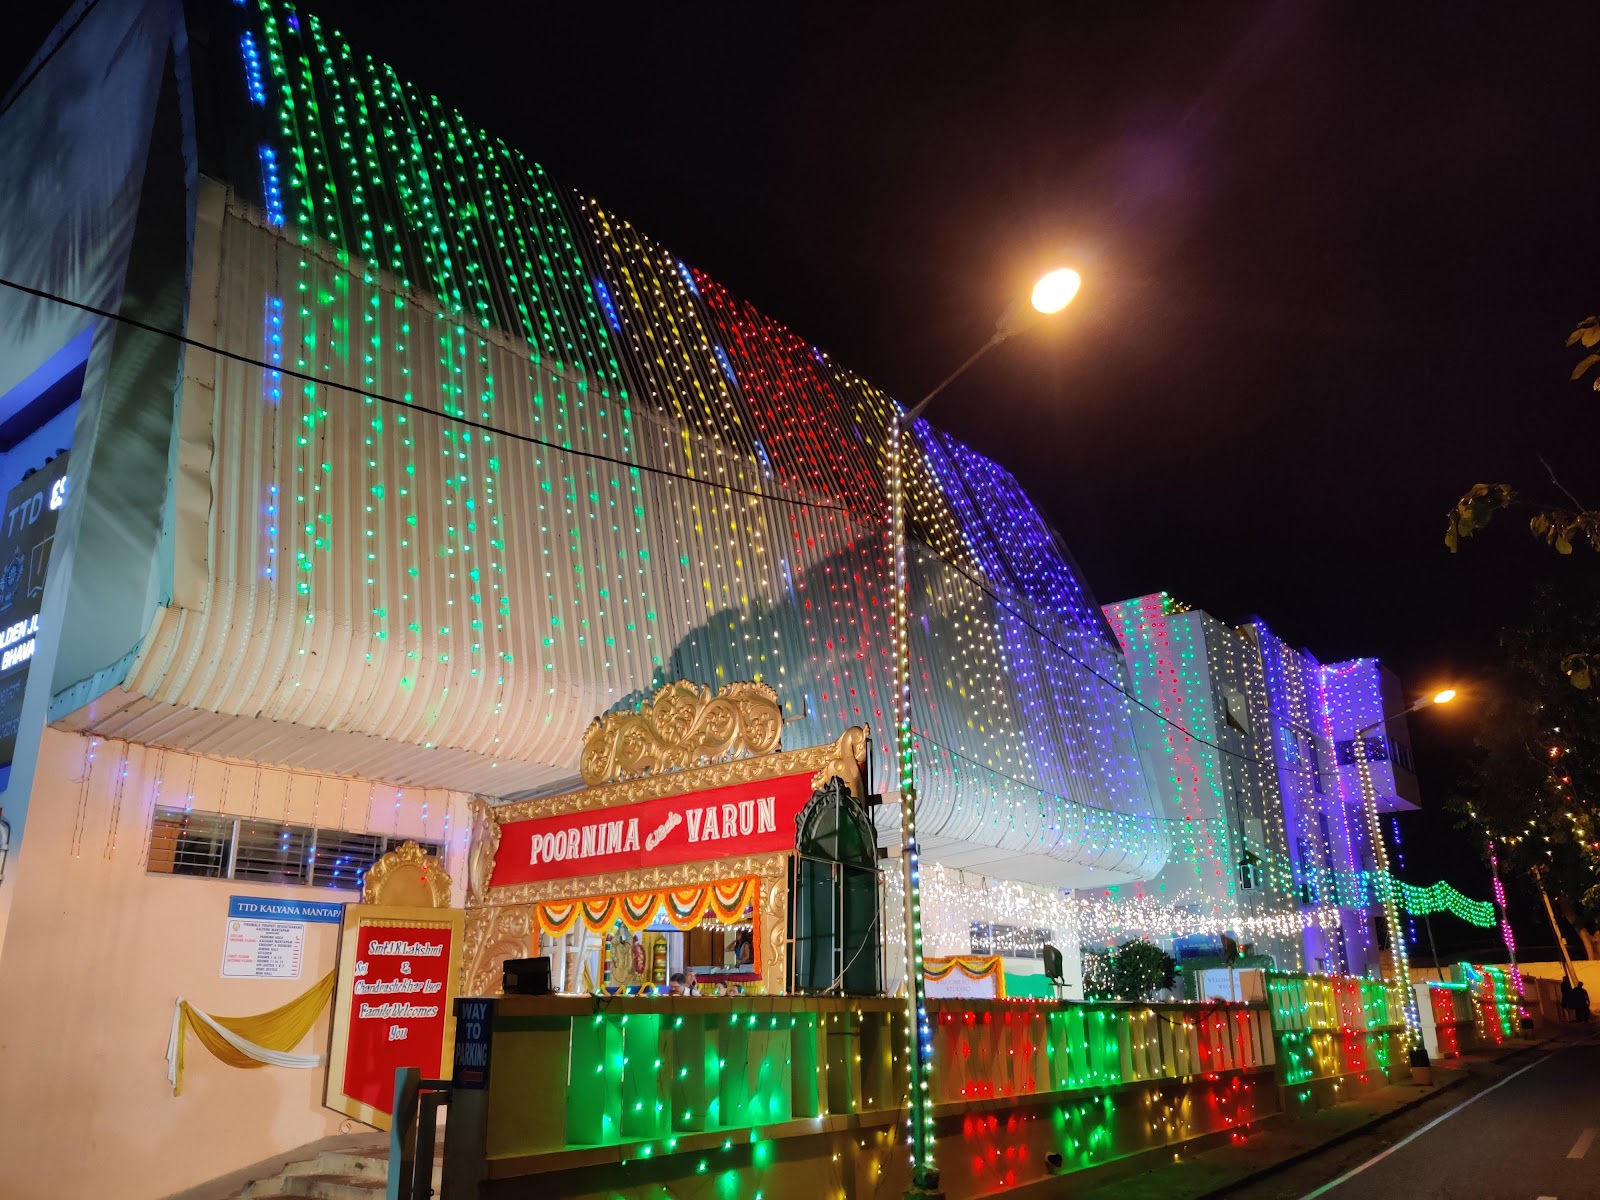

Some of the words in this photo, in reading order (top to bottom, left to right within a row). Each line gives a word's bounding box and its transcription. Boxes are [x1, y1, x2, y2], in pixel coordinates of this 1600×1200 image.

[8, 491, 43, 538] TTD
[0, 619, 27, 648] LDEN
[530, 818, 641, 865] POORNIMA
[686, 797, 776, 842] VARUN
[238, 903, 257, 912] TTD
[260, 905, 300, 915] KALYANA
[400, 961, 412, 975] &
[359, 1003, 392, 1019] Family
[391, 1002, 439, 1018] Welcomes
[462, 1003, 487, 1020] WAY
[388, 1025, 408, 1041] You
[466, 1022, 481, 1039] TO
[455, 1042, 487, 1066] PARKING
